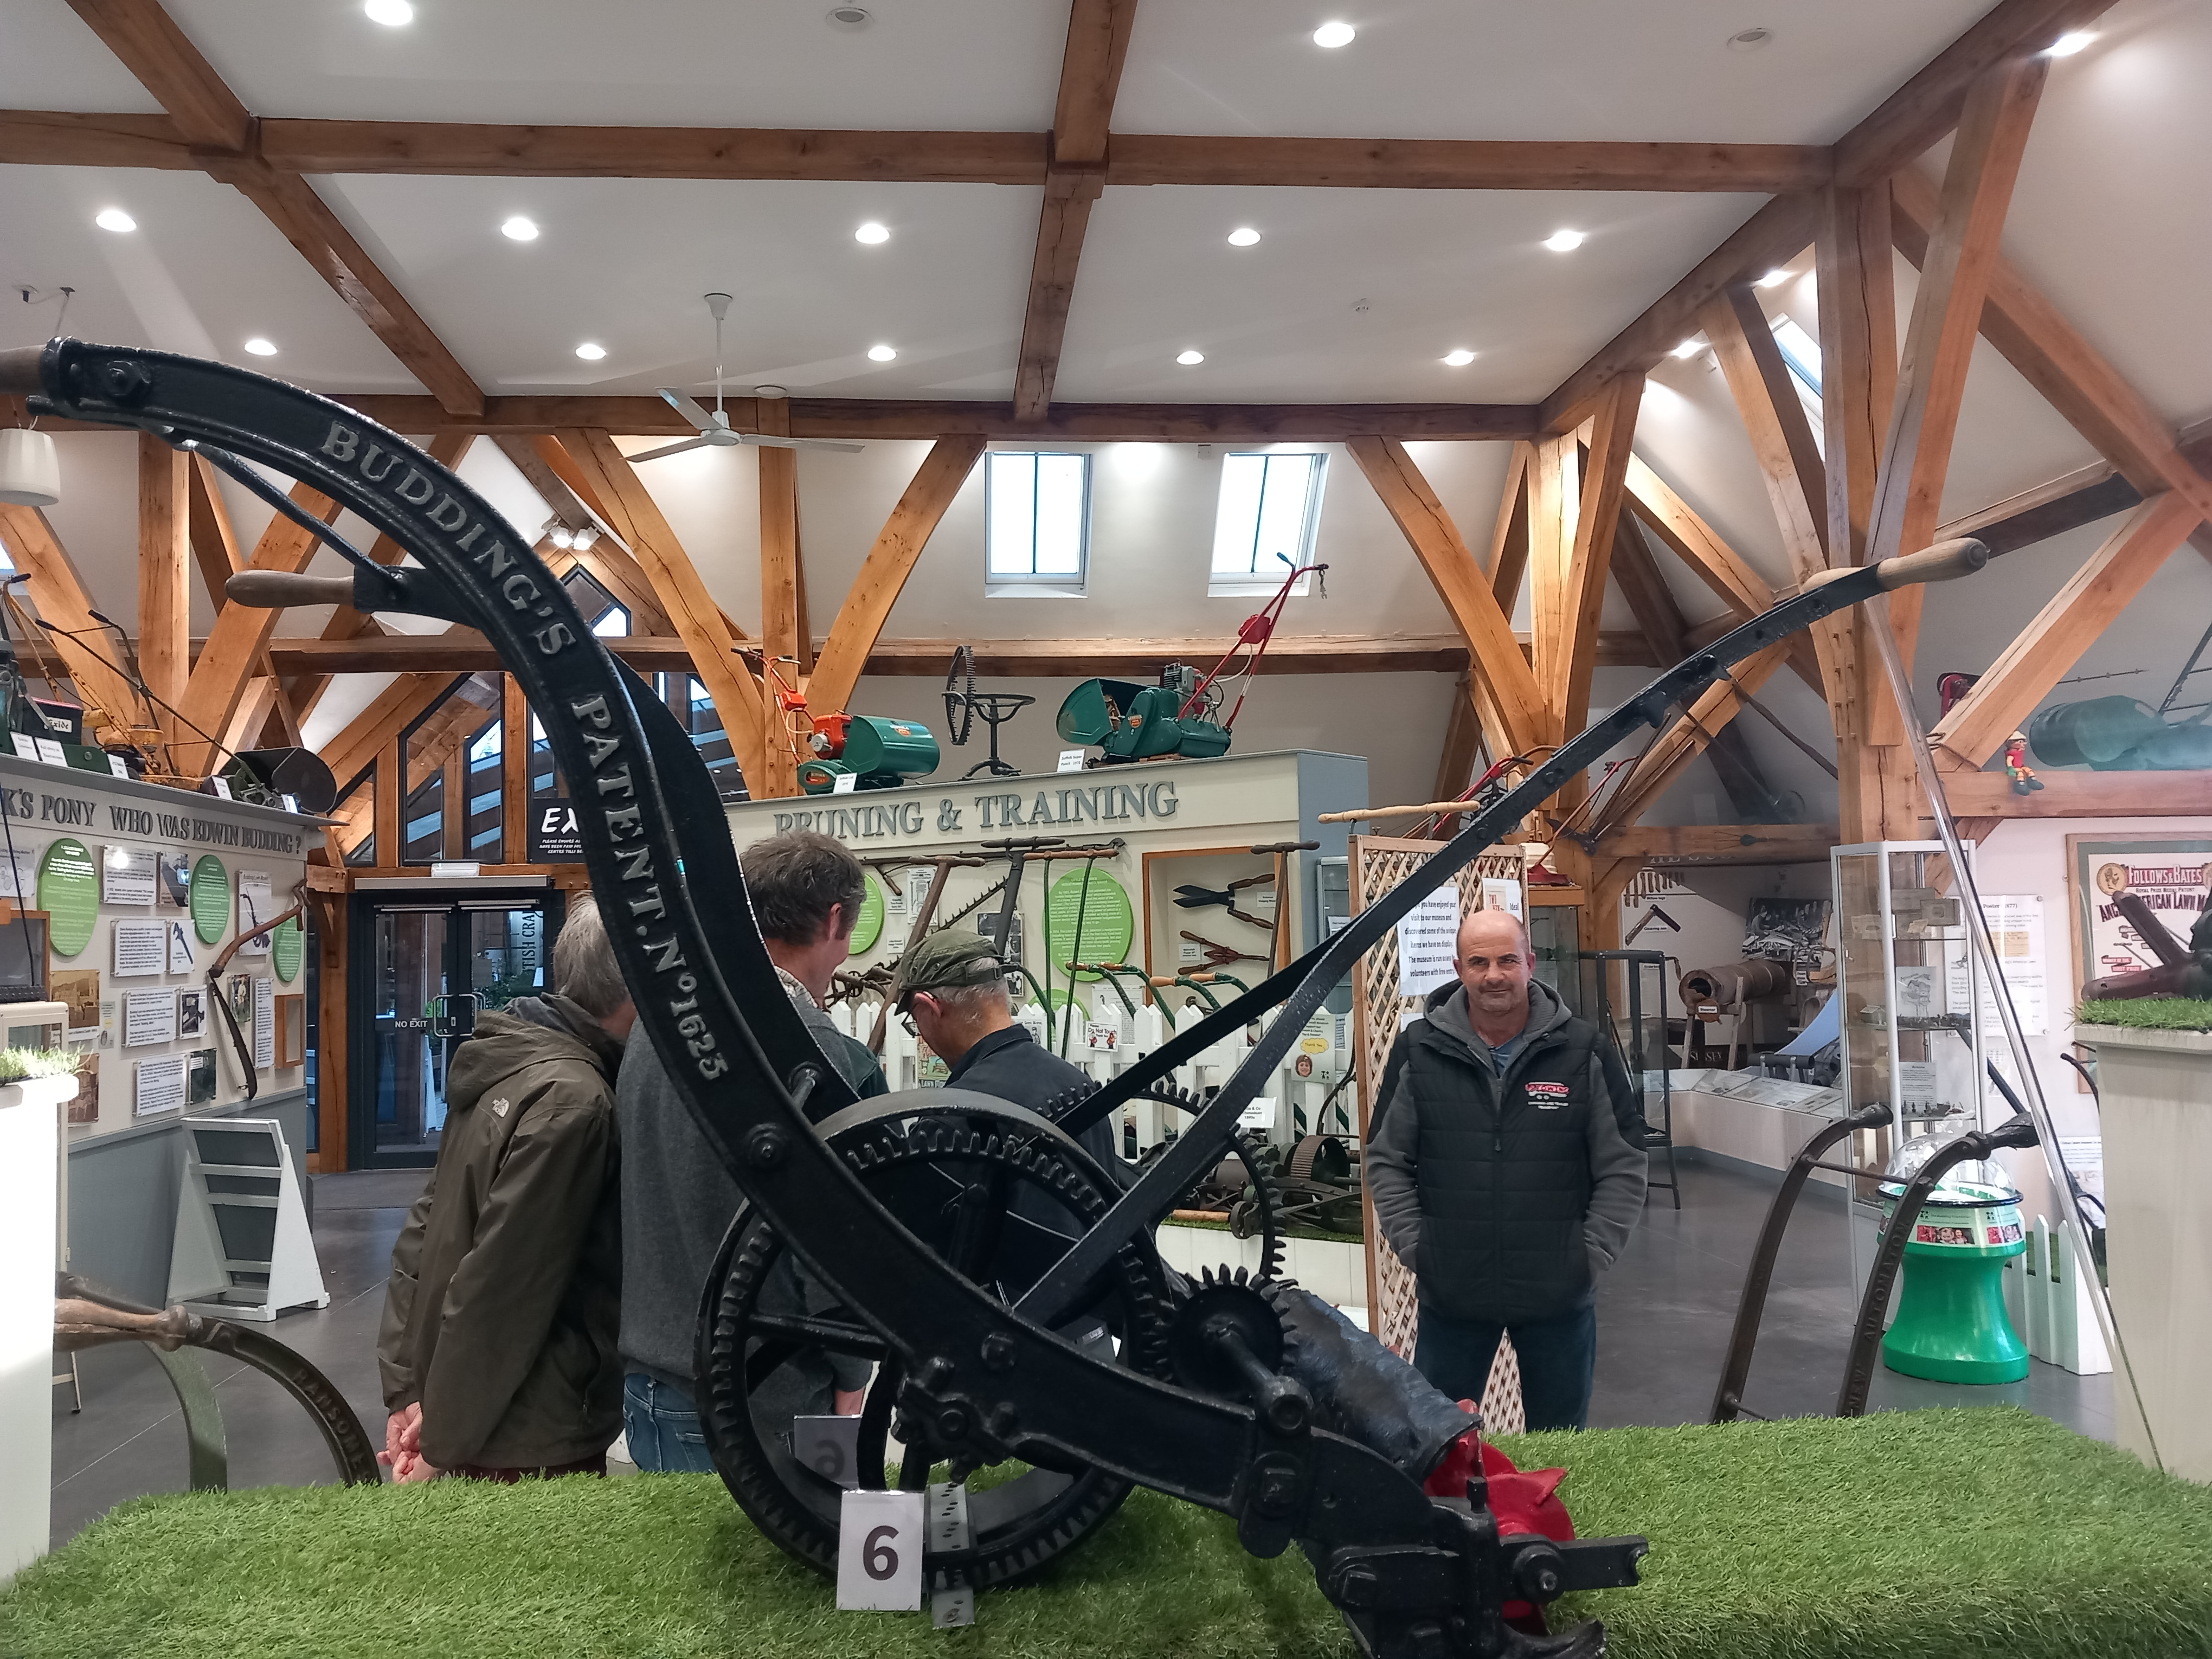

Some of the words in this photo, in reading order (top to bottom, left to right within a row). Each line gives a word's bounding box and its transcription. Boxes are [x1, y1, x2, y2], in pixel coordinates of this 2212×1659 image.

[321, 421, 577, 655] BUDDING'S
[41, 794, 98, 827] PONY
[541, 807, 580, 834] EX
[774, 802, 924, 838] PRUNING
[937, 798, 962, 832] &
[975, 781, 1178, 828] TRAINING
[109, 805, 153, 835] WHO
[157, 813, 190, 840] WAS
[192, 819, 240, 846] EDWIN
[241, 826, 293, 854] BUDDING
[1437, 901, 1449, 909] enjoyed
[1509, 903, 1520, 911] Ideal
[2174, 892, 2196, 910] LAWN
[522, 911, 535, 938] CRA
[863, 1525, 899, 1581] 6
